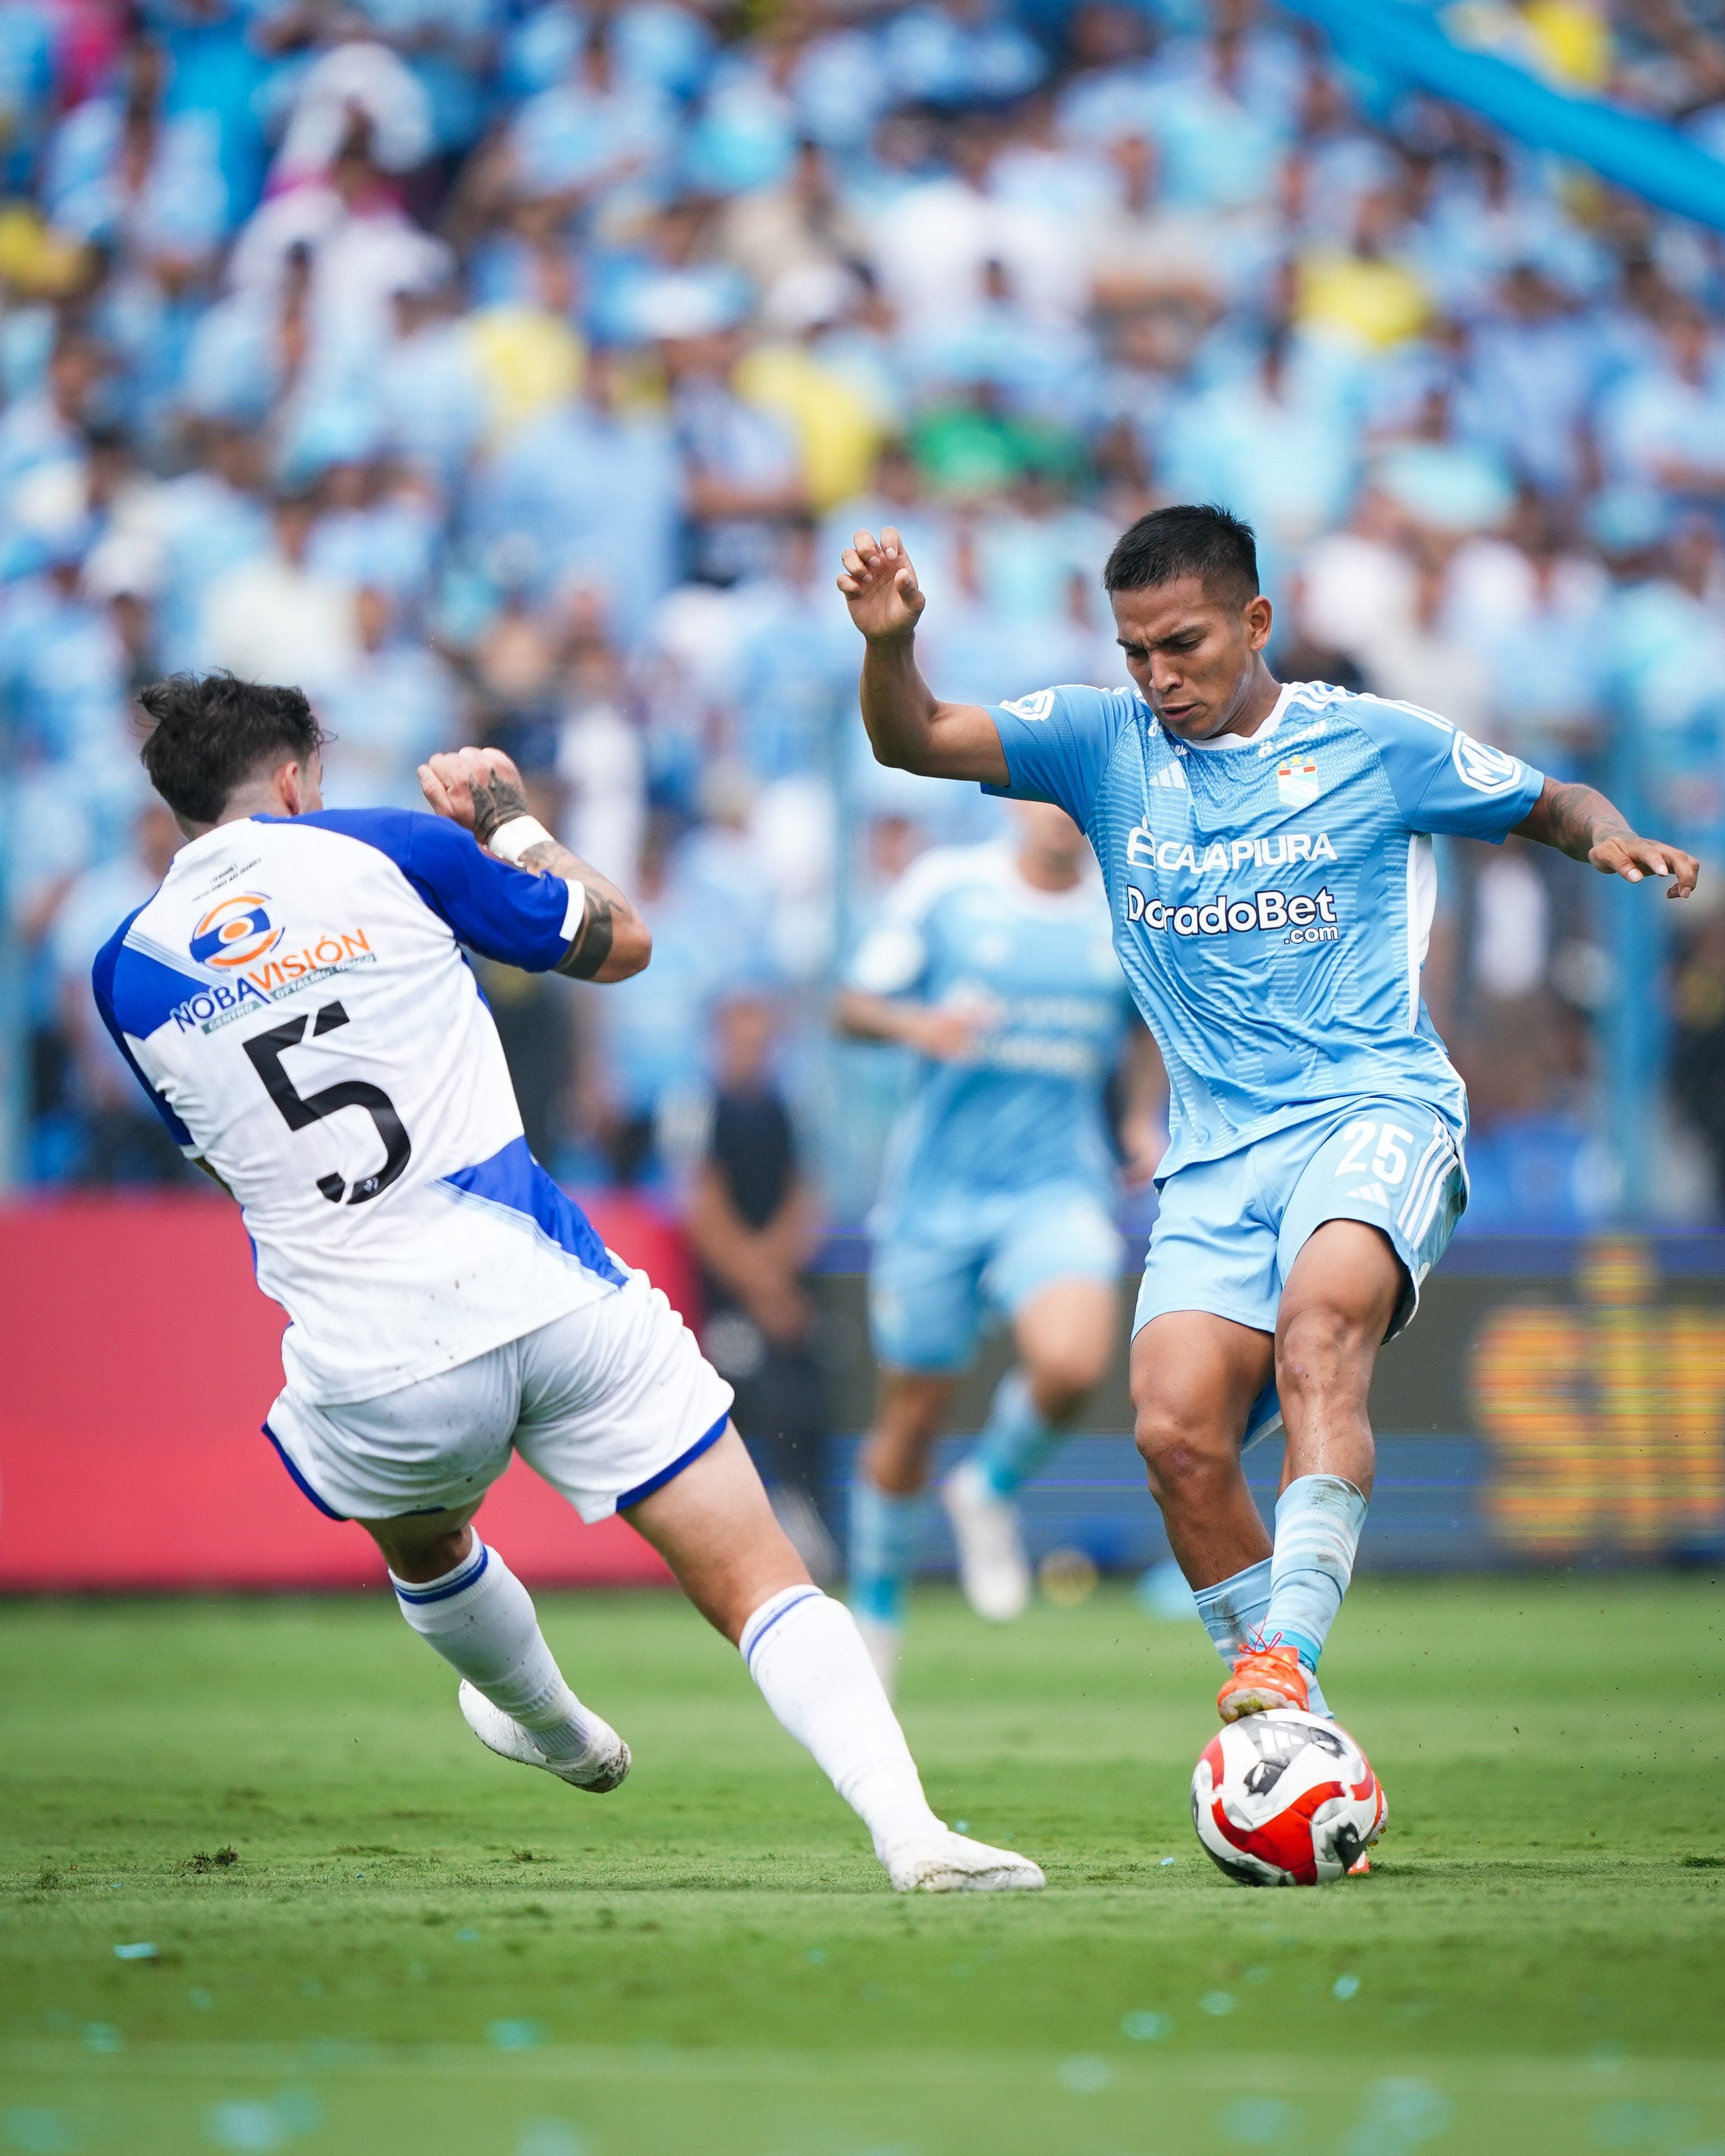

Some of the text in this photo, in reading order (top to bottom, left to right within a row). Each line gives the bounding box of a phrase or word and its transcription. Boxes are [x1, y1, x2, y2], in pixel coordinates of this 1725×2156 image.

[1126, 885, 1338, 936] DoradoBet
[1284, 925, 1340, 944] .com
[172, 928, 371, 1033] NOBAVISIÓN
[242, 1000, 411, 1205] 5
[1334, 1121, 1414, 1185] 25
